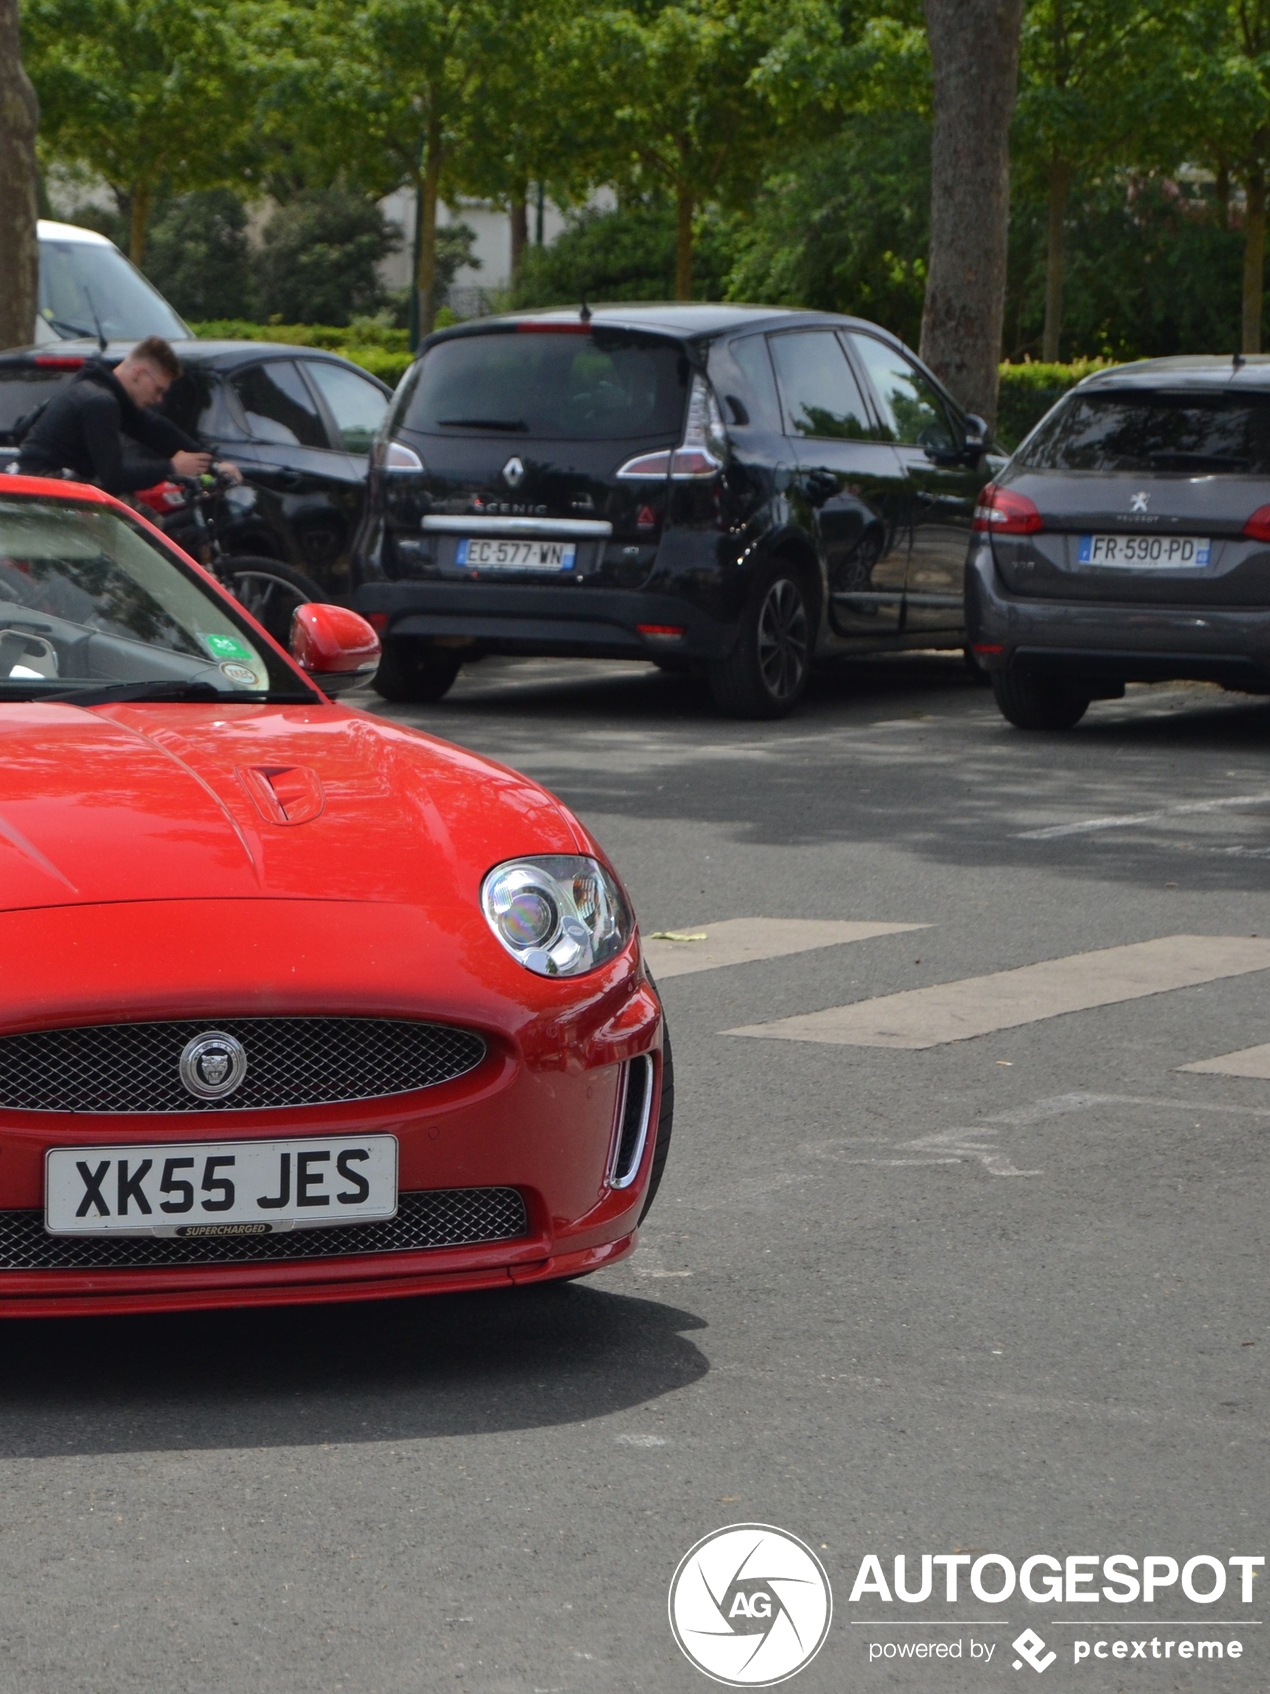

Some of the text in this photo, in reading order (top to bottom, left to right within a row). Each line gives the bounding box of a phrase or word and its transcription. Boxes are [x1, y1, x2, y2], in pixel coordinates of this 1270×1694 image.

[468, 541, 563, 564] EC-577-WN
[1092, 538, 1194, 560] FR-590-PD
[76, 1149, 370, 1218] XK55 JES
[185, 1223, 267, 1237] SUPERCHARGED
